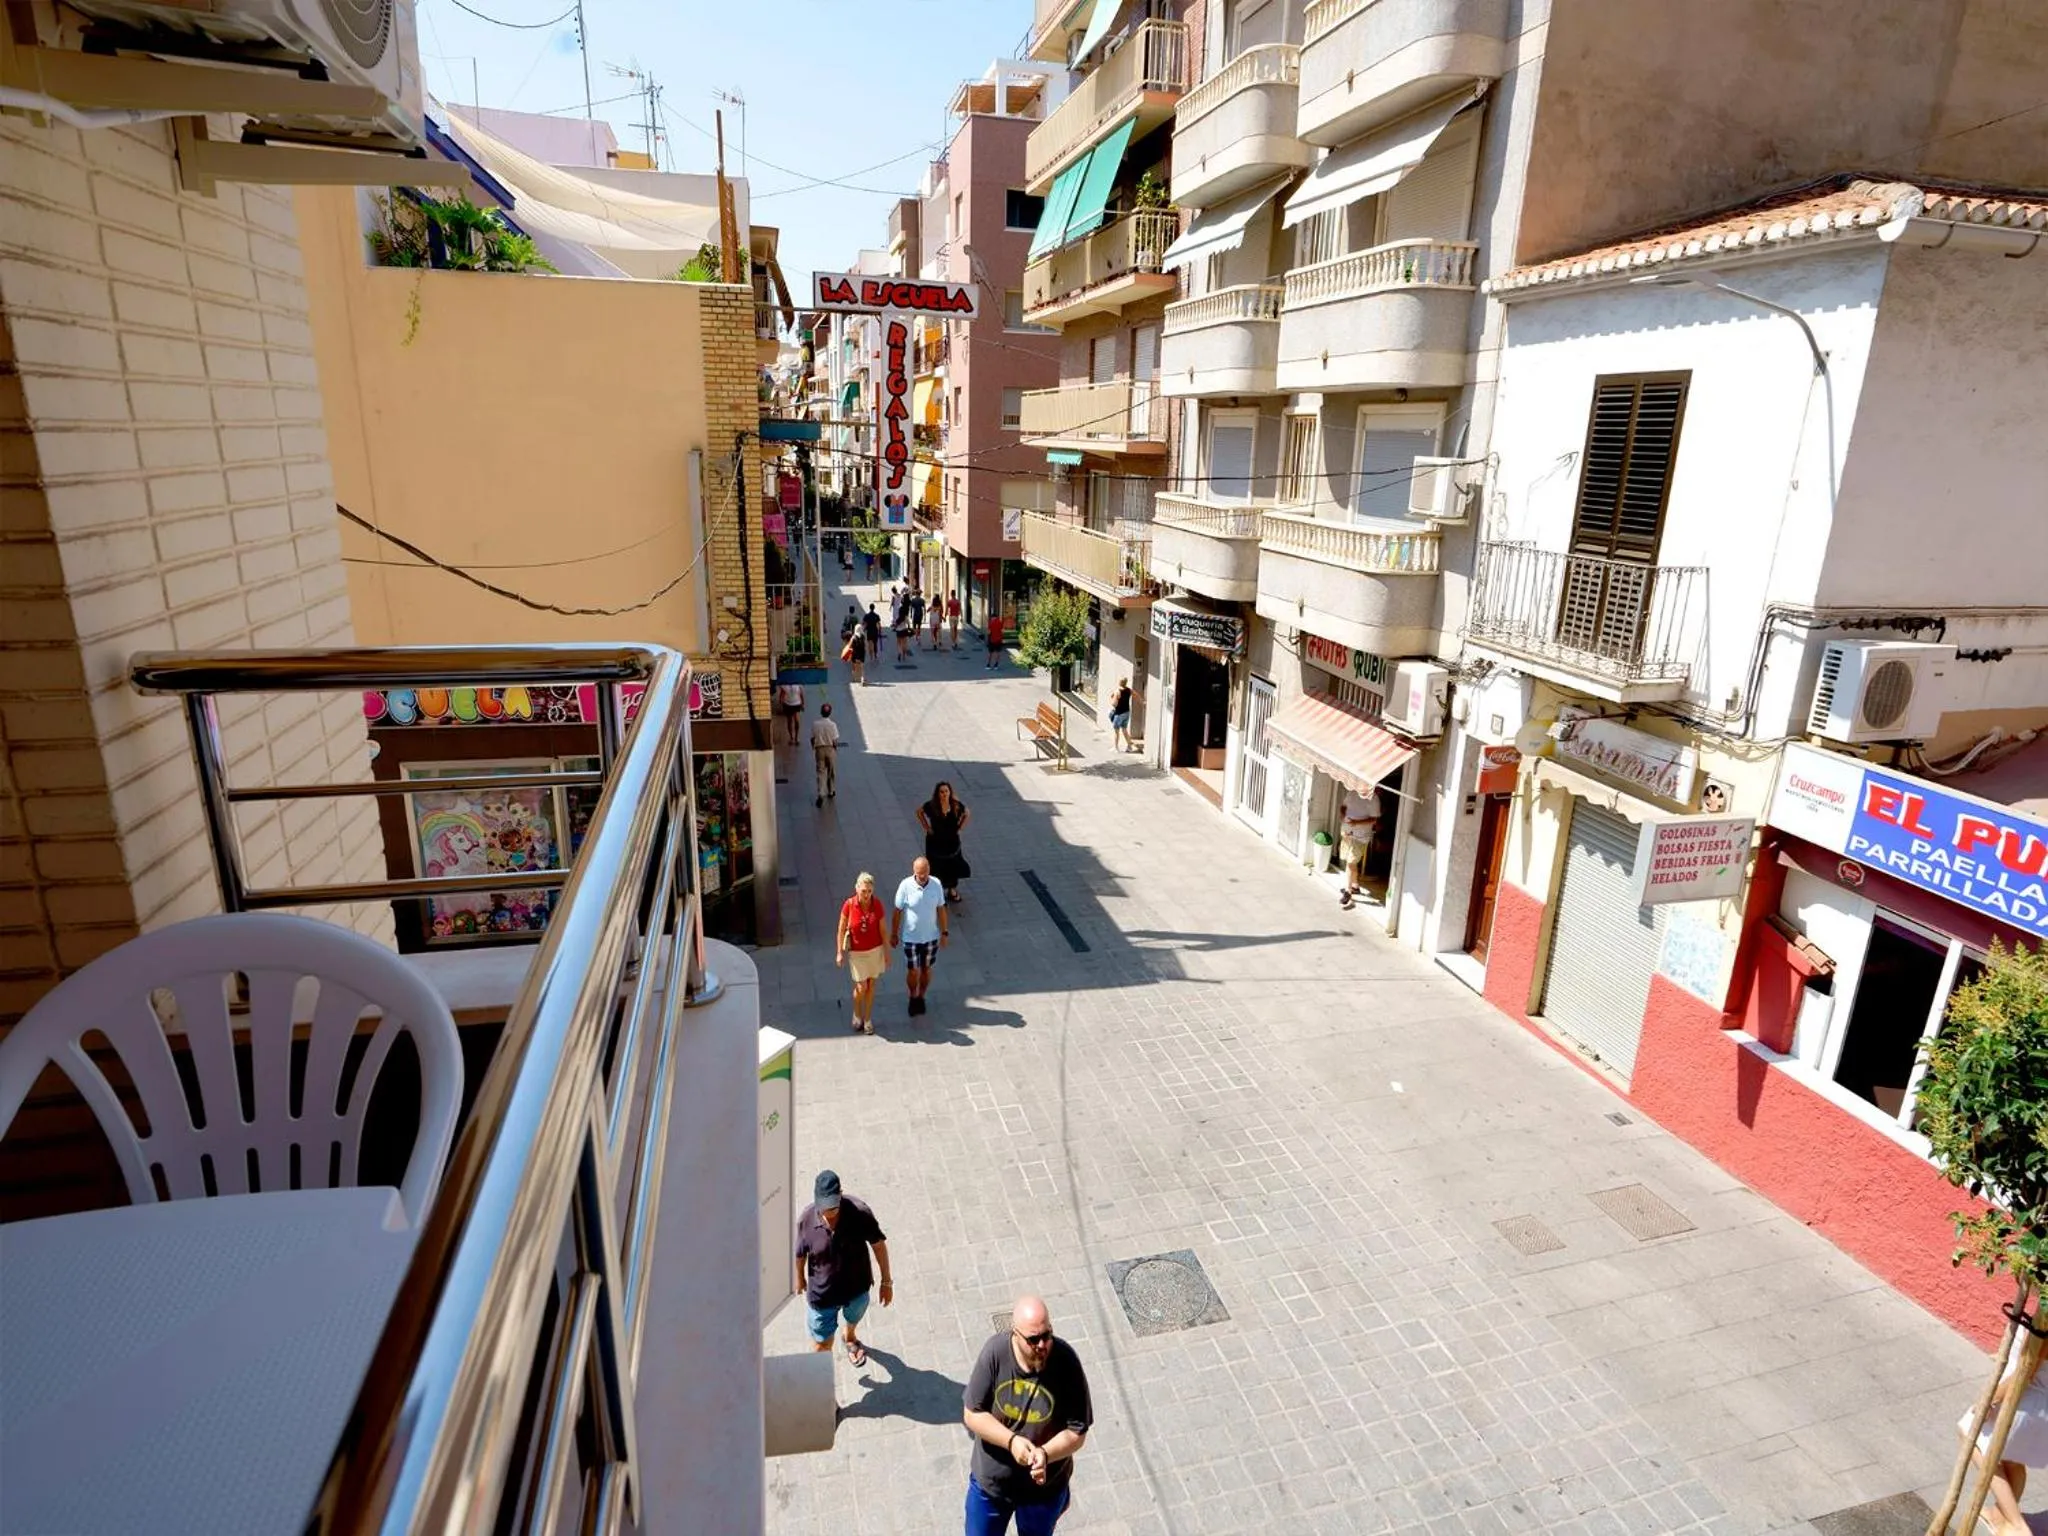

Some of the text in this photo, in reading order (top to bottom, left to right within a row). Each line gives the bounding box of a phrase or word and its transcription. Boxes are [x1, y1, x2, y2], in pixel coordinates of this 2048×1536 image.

[819, 277, 973, 313] LA ESCUELA
[885, 321, 909, 489] REGALOS
[1172, 624, 1180, 632] &
[1307, 635, 1347, 669] FRUTAS
[1790, 774, 1845, 804] Cruzcampo
[1660, 826, 1717, 840] GOLOSINAS
[1863, 779, 2048, 884] EL PU
[1654, 854, 1731, 870] BEBIDAS FRIAS
[1656, 840, 1732, 855] BOLSAS FIESTA
[1651, 871, 1699, 884] HELADOS
[1909, 839, 2047, 906] PAELLA
